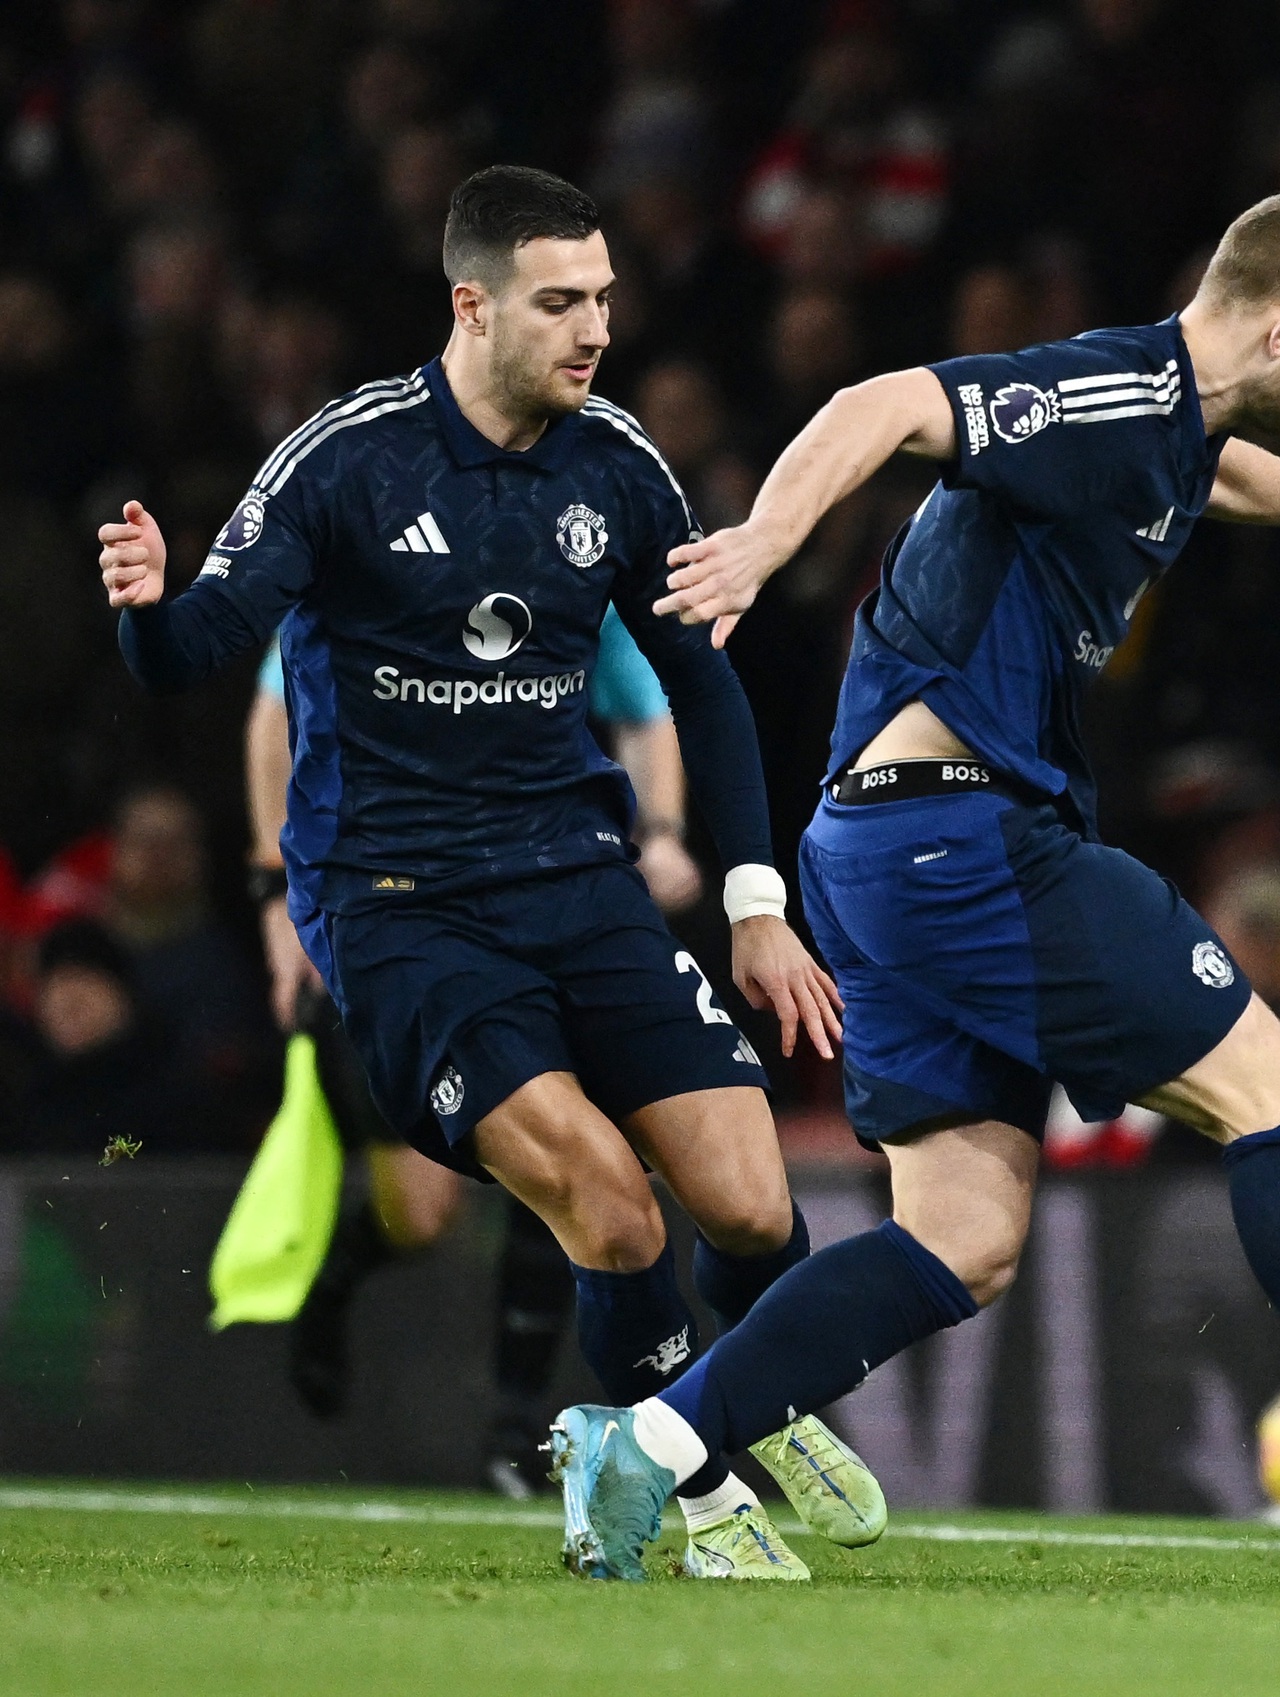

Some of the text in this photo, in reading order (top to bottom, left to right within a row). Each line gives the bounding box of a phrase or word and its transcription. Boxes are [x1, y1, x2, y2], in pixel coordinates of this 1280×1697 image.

[974, 406, 990, 448] room
[568, 551, 599, 564] UNITED
[372, 665, 586, 715] Snapdragon
[861, 765, 990, 790] BOSS BOSS
[675, 950, 734, 1025] 2
